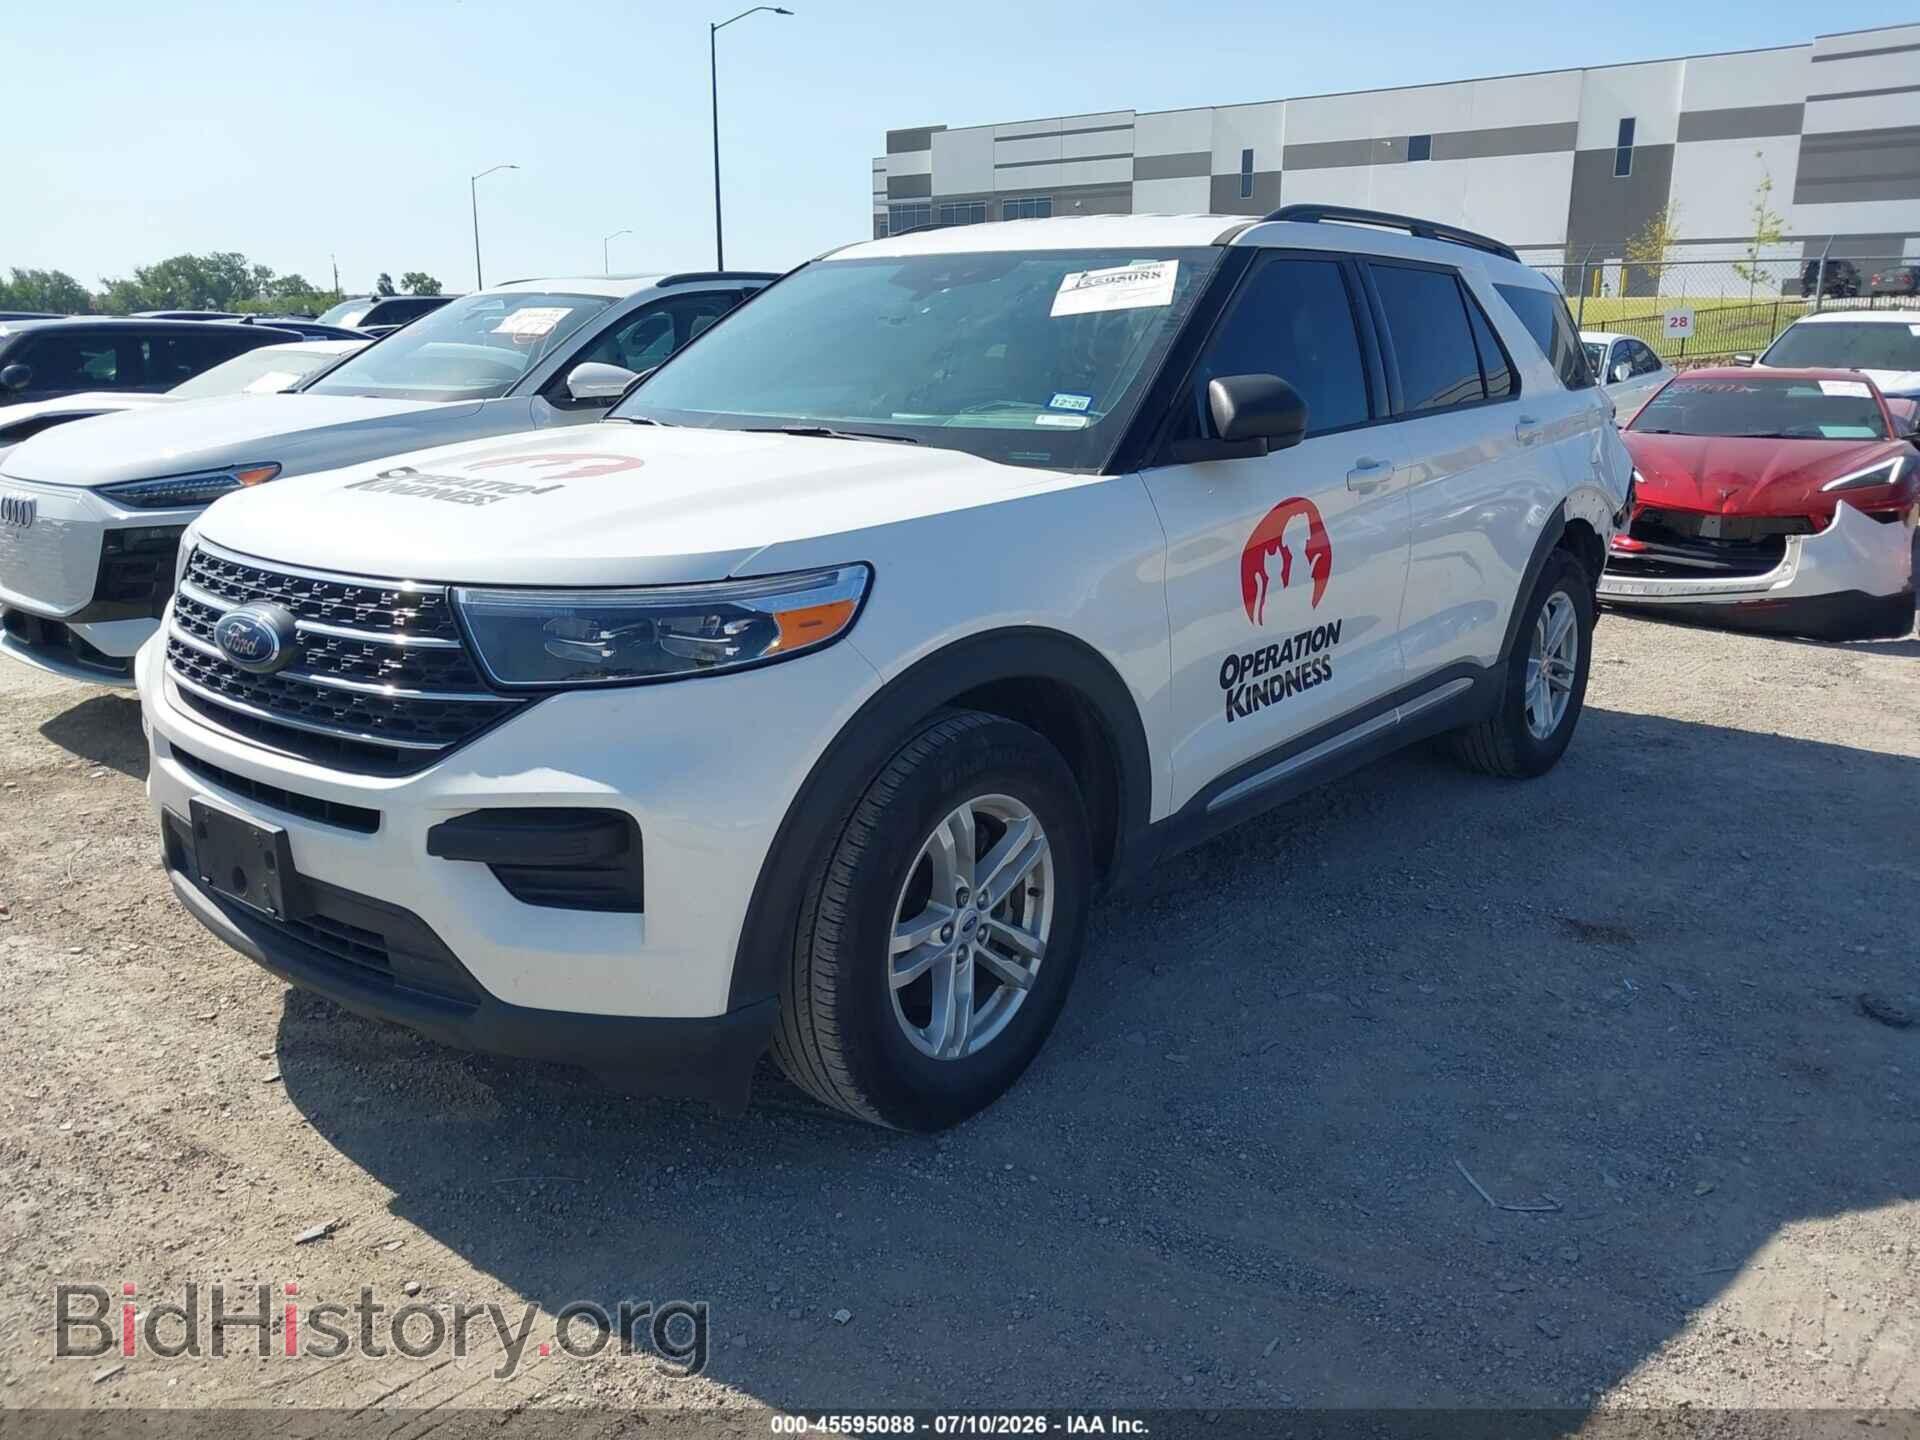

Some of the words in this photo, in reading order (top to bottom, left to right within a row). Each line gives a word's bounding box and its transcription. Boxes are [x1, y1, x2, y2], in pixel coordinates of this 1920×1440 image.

[1669, 316, 1688, 328] 28
[223, 621, 260, 657] Ford
[1219, 618, 1342, 690] OPERATION
[1226, 653, 1333, 723] KINDNESS
